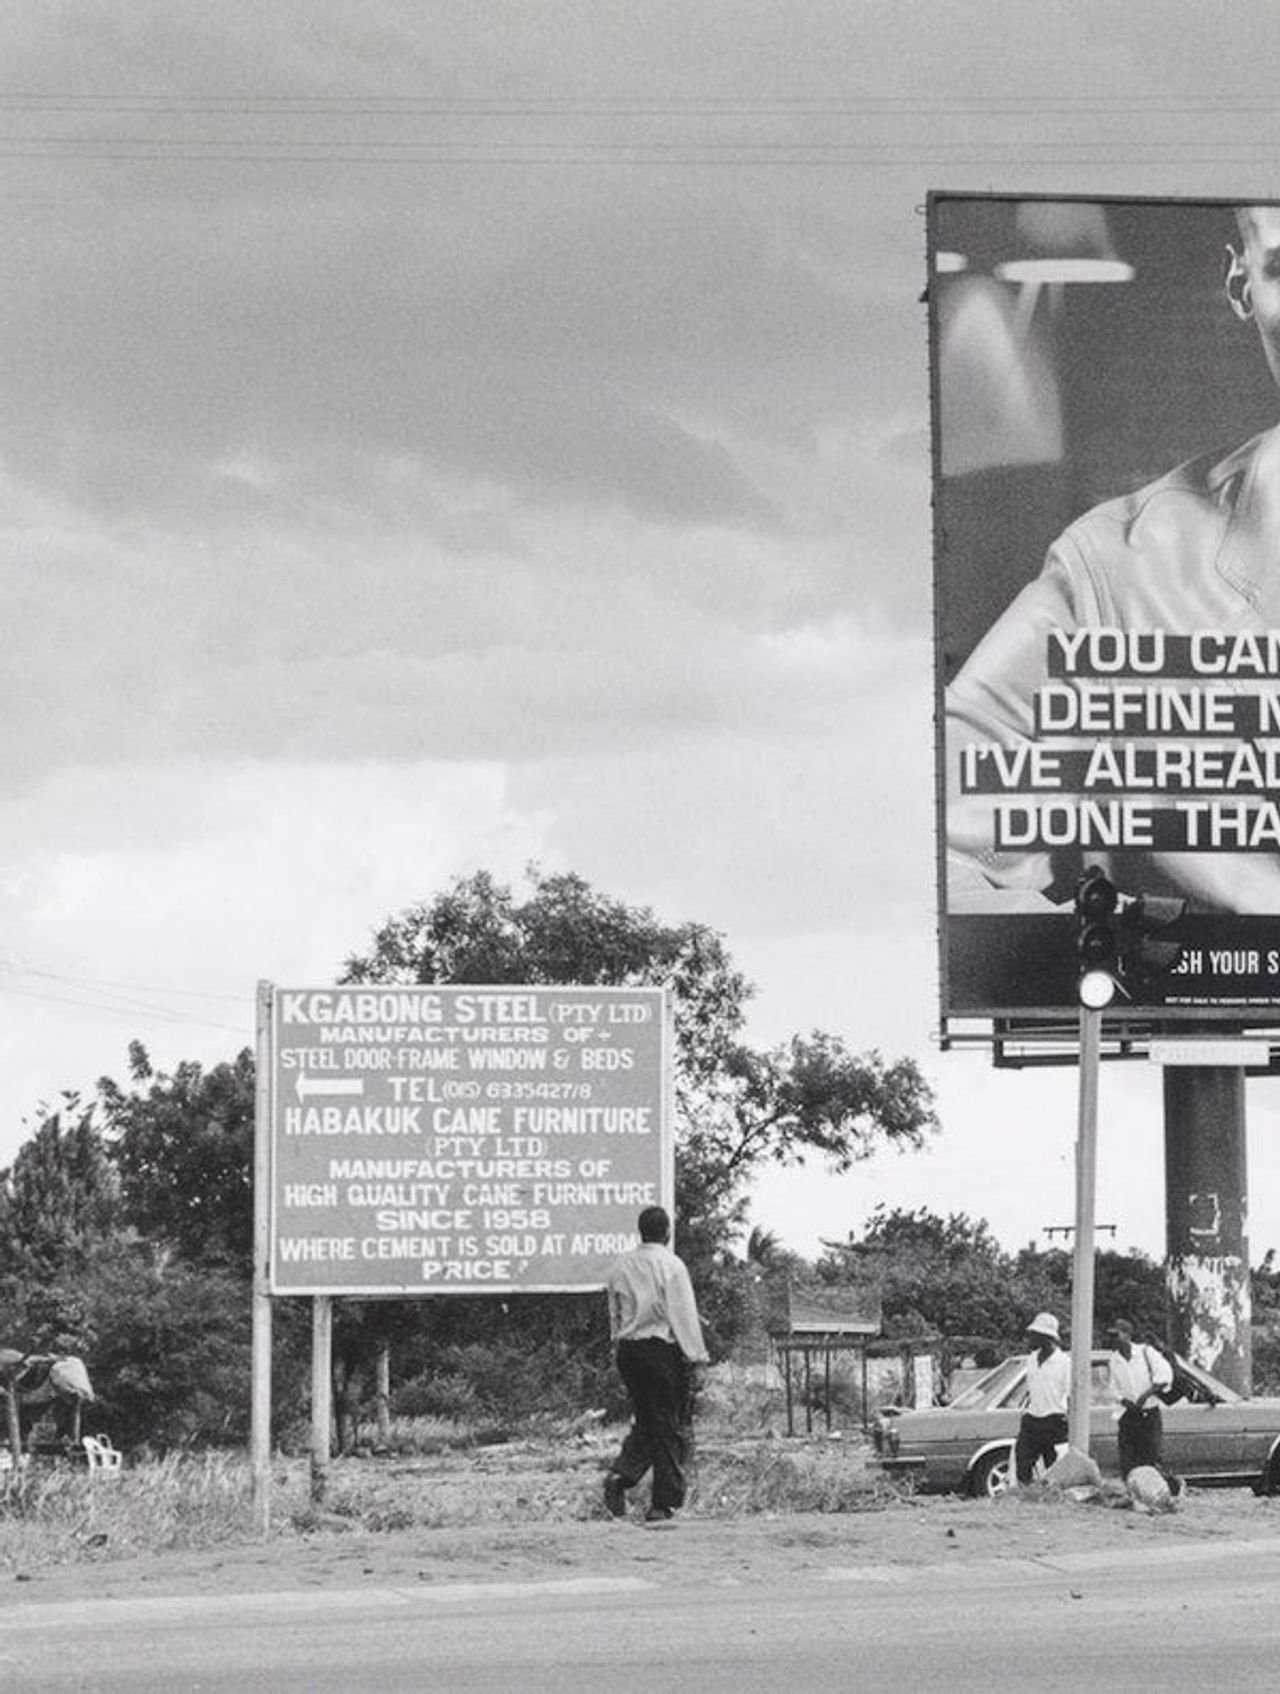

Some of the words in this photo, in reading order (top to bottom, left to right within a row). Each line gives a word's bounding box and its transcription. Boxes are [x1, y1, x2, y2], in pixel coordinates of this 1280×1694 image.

[1053, 627, 1165, 673] YOU
[1040, 685, 1235, 732] DEFINE
[962, 742, 1062, 787] I'VE
[999, 801, 1154, 846] DONE
[1209, 950, 1260, 975] YOUR
[281, 993, 443, 1024] KGABONG
[454, 994, 547, 1024] STEEL
[549, 1002, 602, 1024] (PTY
[608, 1003, 653, 1024] LTD)
[320, 1026, 549, 1043] MANUFACTURERS
[280, 1047, 340, 1069] STEEL
[467, 1048, 546, 1070] WINDOW
[553, 1048, 570, 1069] &
[581, 1048, 634, 1070] BEDS
[387, 1077, 443, 1103] TEL
[285, 1106, 422, 1135] HABAKUK
[433, 1106, 501, 1134] CANE
[513, 1106, 652, 1134] FURNITURE
[425, 1136, 487, 1158] (PTY
[495, 1136, 547, 1158] LTD)
[329, 1159, 572, 1179] MANUFACTURERS
[579, 1159, 612, 1178] OF
[284, 1183, 338, 1207] HIGH
[347, 1183, 450, 1207] QUALITY
[463, 1183, 522, 1206] CANE
[533, 1181, 657, 1206] FURNITURE
[375, 1208, 473, 1231] SINCE
[483, 1208, 550, 1230] 1958
[278, 1236, 356, 1262] WHERE
[360, 1236, 452, 1260] CEMENT
[458, 1236, 479, 1257] IS
[486, 1235, 536, 1257] SOLD
[541, 1234, 566, 1257] AT
